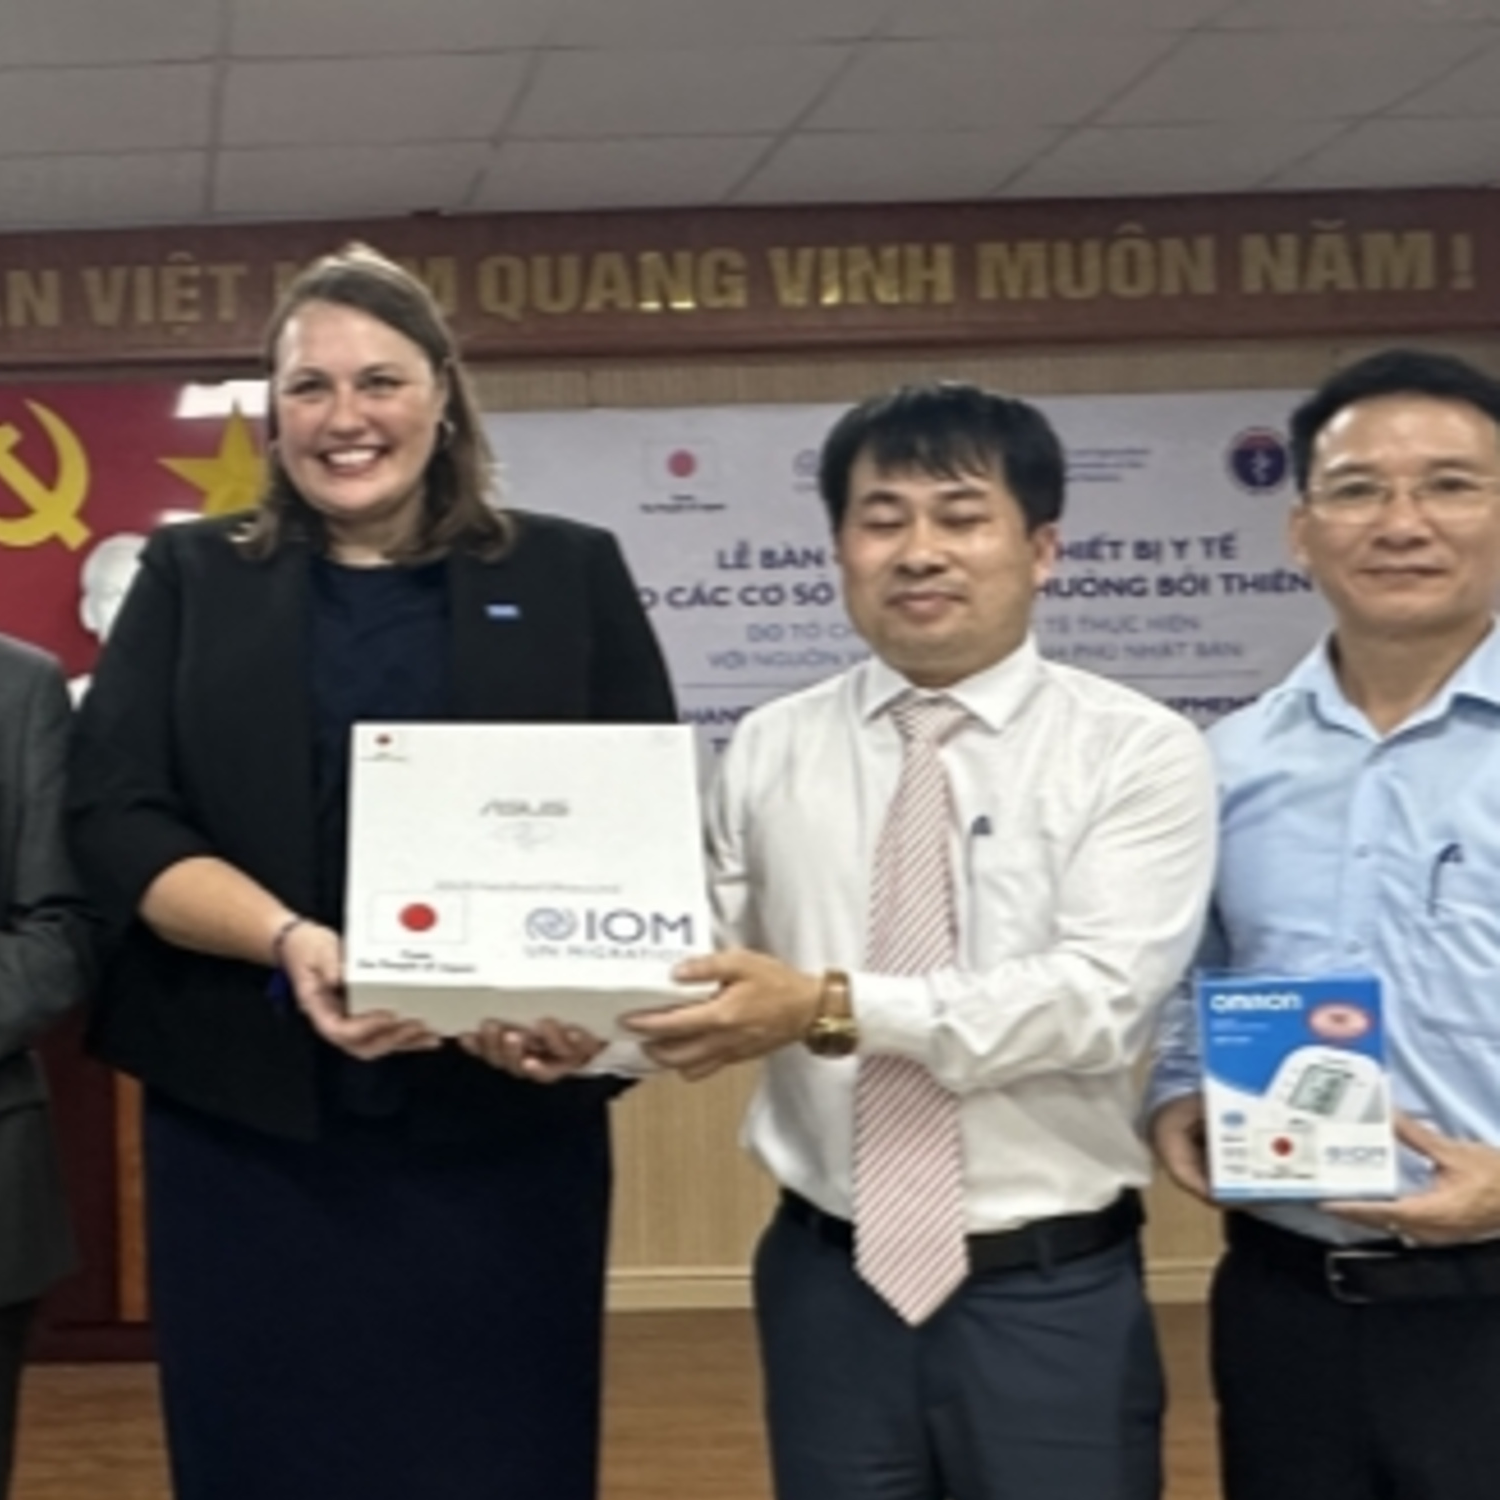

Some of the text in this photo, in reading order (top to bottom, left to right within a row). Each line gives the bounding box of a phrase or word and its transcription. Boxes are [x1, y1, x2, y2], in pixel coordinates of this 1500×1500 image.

[82, 250, 247, 336] VIỆT
[478, 247, 745, 321] QUANG
[768, 243, 953, 305] VINH
[976, 222, 1216, 299] MUÔN
[1201, 530, 1238, 561] TẾ
[585, 907, 695, 947] IOM
